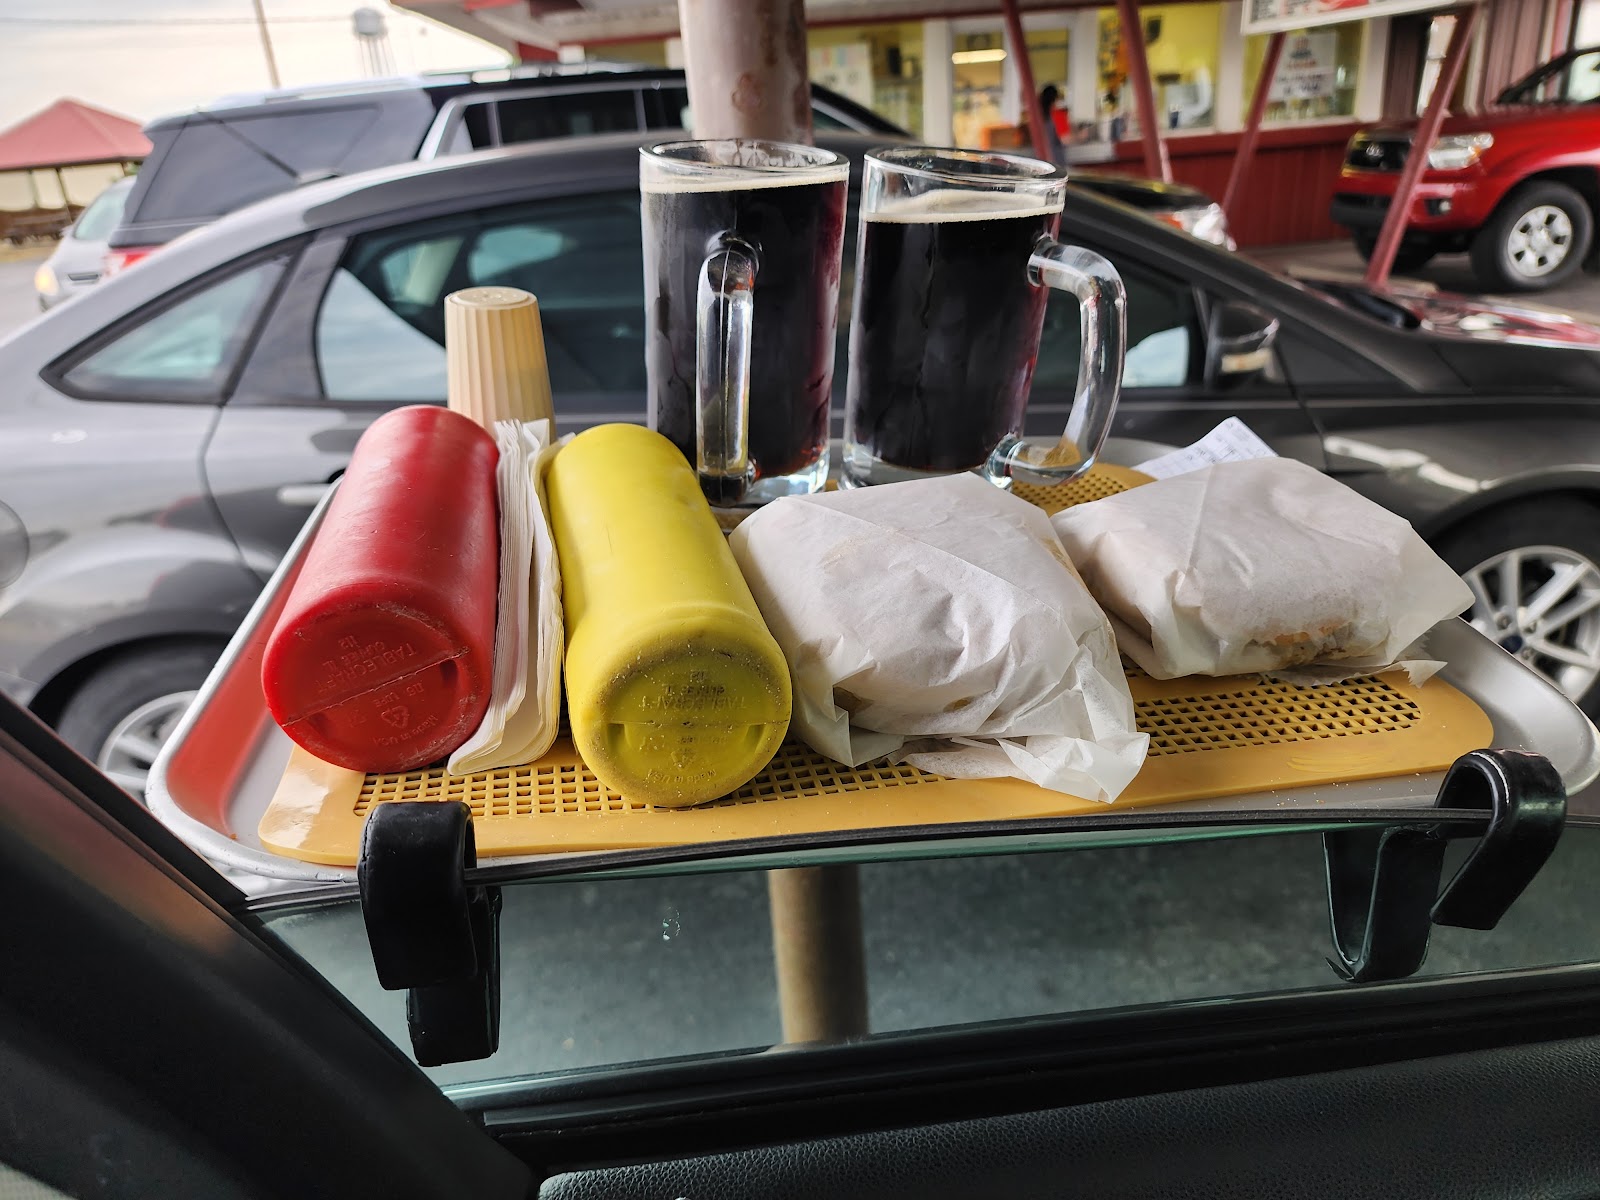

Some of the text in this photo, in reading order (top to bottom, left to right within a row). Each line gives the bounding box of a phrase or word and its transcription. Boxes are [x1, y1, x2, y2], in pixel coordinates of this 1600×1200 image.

[314, 642, 418, 695] TABLECRAFT
[641, 695, 747, 711] TABLECRAFT
[372, 713, 439, 747] Made in USA
[646, 769, 671, 784] USA
[686, 768, 717, 784] Made
